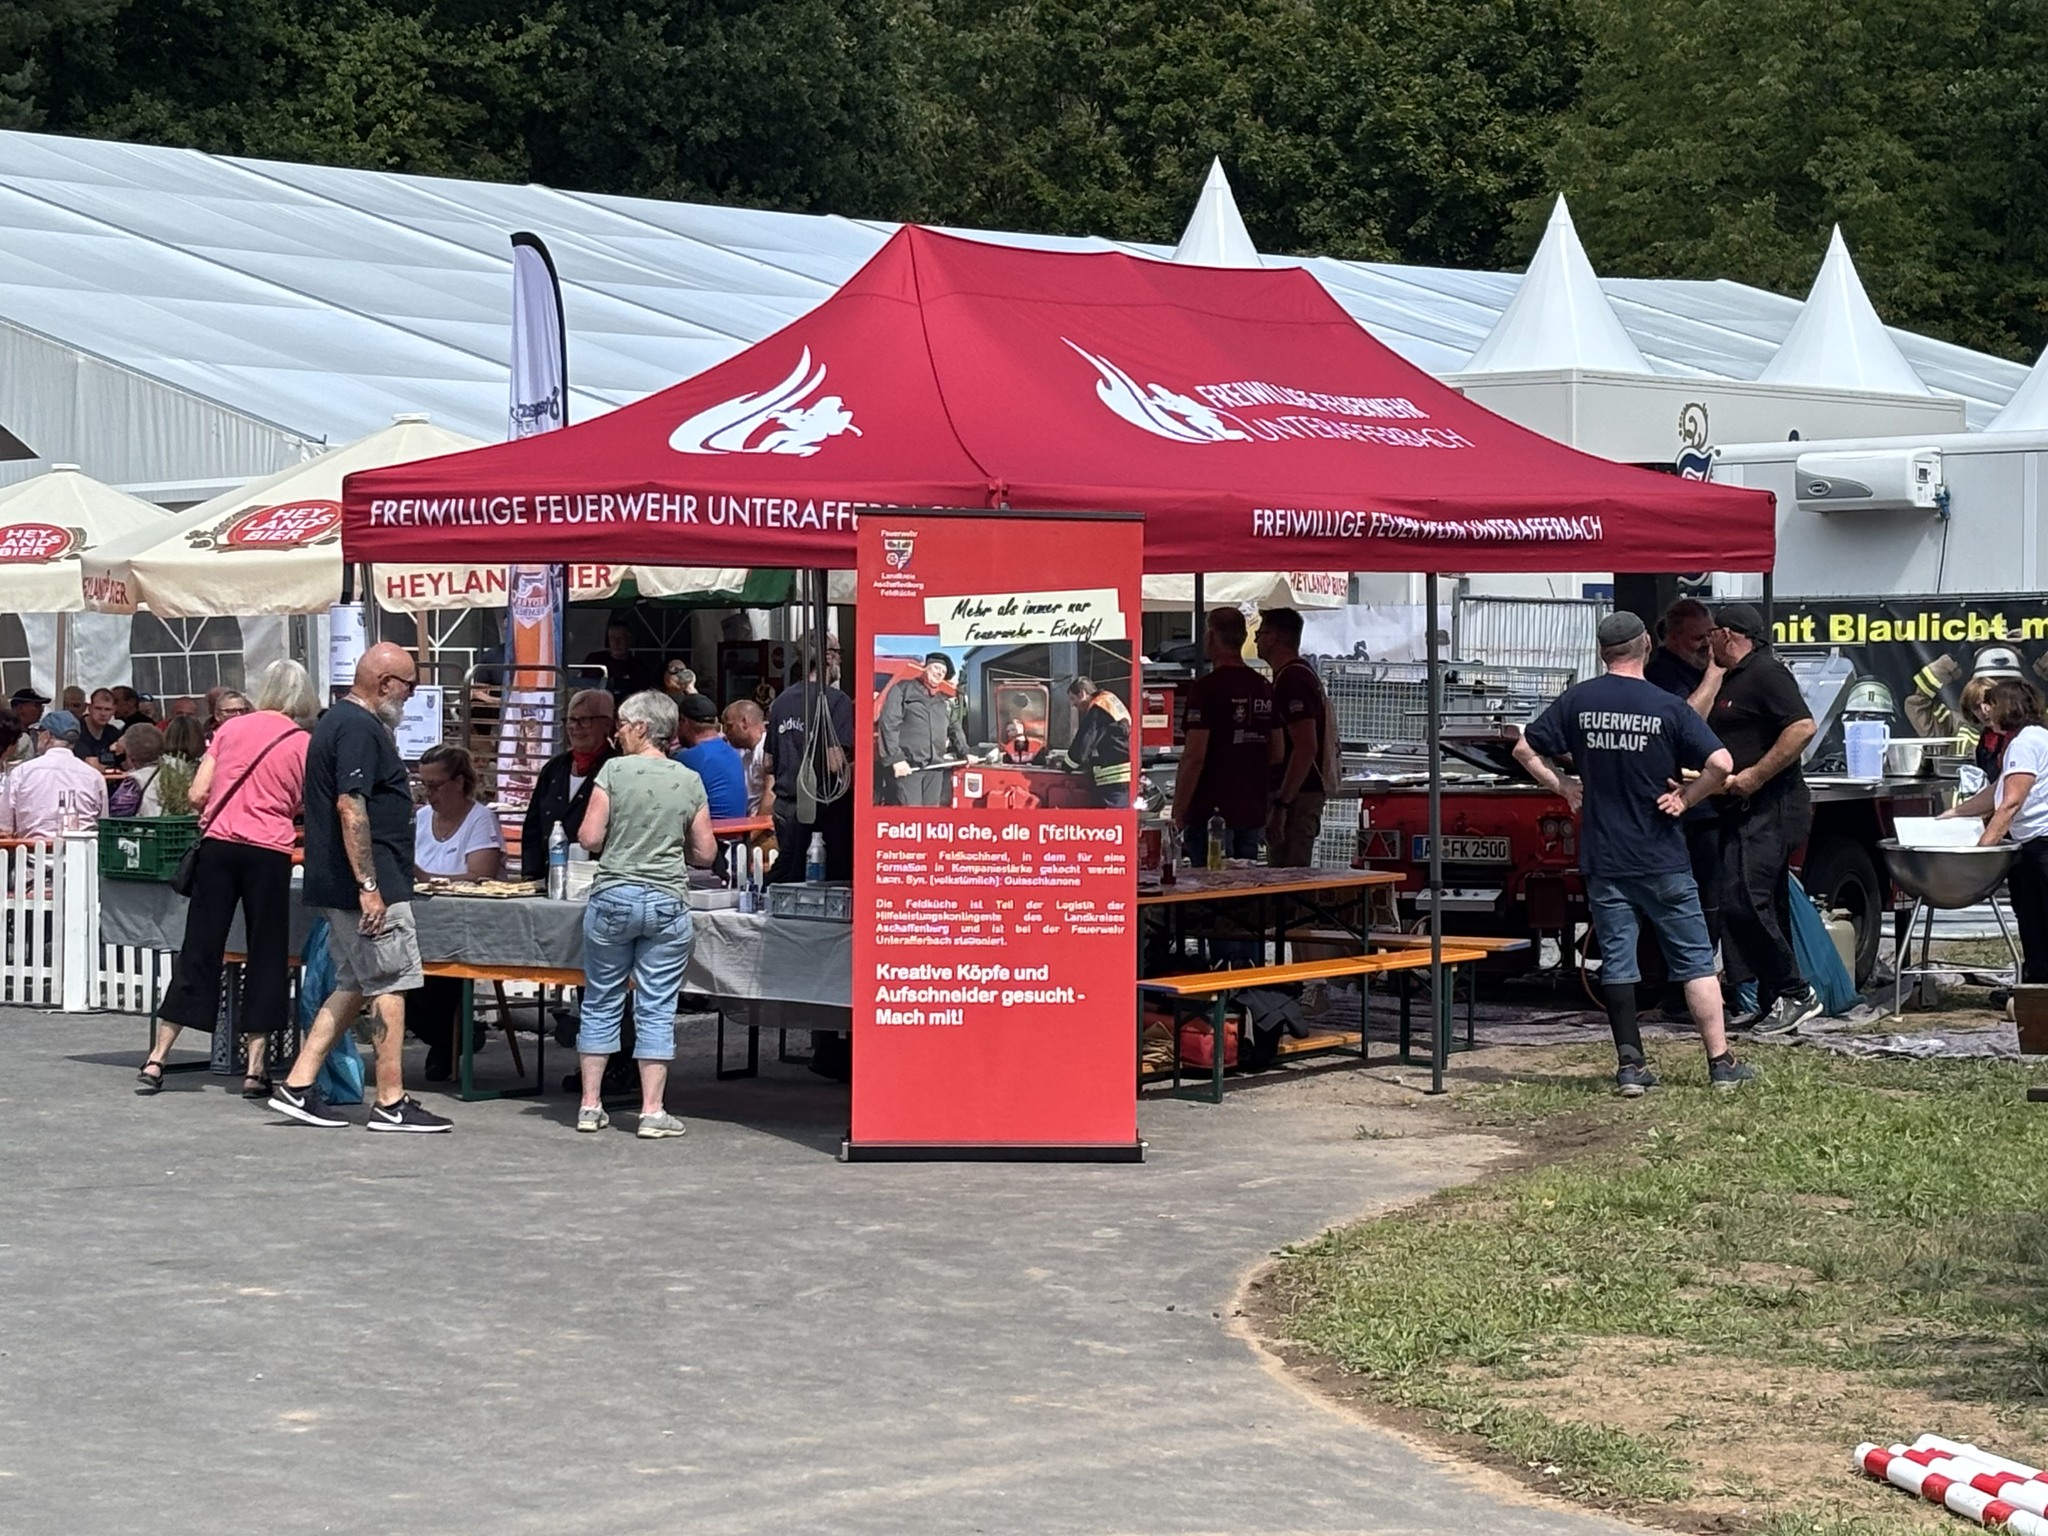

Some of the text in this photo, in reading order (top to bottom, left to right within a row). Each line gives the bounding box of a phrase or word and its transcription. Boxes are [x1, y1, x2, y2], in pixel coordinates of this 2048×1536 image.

[271, 507, 331, 519] HEY
[370, 497, 528, 527] FREIWILLIGE
[536, 492, 699, 524] FEUERWEHR
[6, 529, 52, 539] HEY
[1253, 508, 1365, 538] FREIWILLIGE
[1462, 515, 1602, 541] UNTERAFFERBACH
[0, 535, 62, 547] ANDS
[242, 529, 304, 541] BIER
[0, 547, 46, 556] BIER
[386, 565, 612, 598] HEYLAN IER
[951, 599, 993, 620] Mehr
[997, 597, 1019, 616] als
[1022, 599, 1063, 615] immer
[1050, 617, 1103, 644] Eintopf!
[1829, 612, 2008, 643] Blaulicht
[1578, 711, 1662, 735] FEUERWEHR
[1586, 732, 1648, 752] SAILAUF
[958, 823, 998, 843] che,
[1001, 824, 1030, 841] die
[1451, 841, 1469, 858] FK
[1472, 841, 1507, 859] 2500
[876, 899, 894, 909] Die
[1026, 900, 1044, 910] der
[1107, 901, 1126, 911] der
[961, 924, 981, 934] und
[1042, 924, 1061, 935] der
[876, 963, 1049, 984] Kreative Köpfe und
[875, 986, 999, 1004] Aufschneider
[1001, 986, 1076, 1007] gesucht
[876, 1008, 964, 1025] Mach mit!
